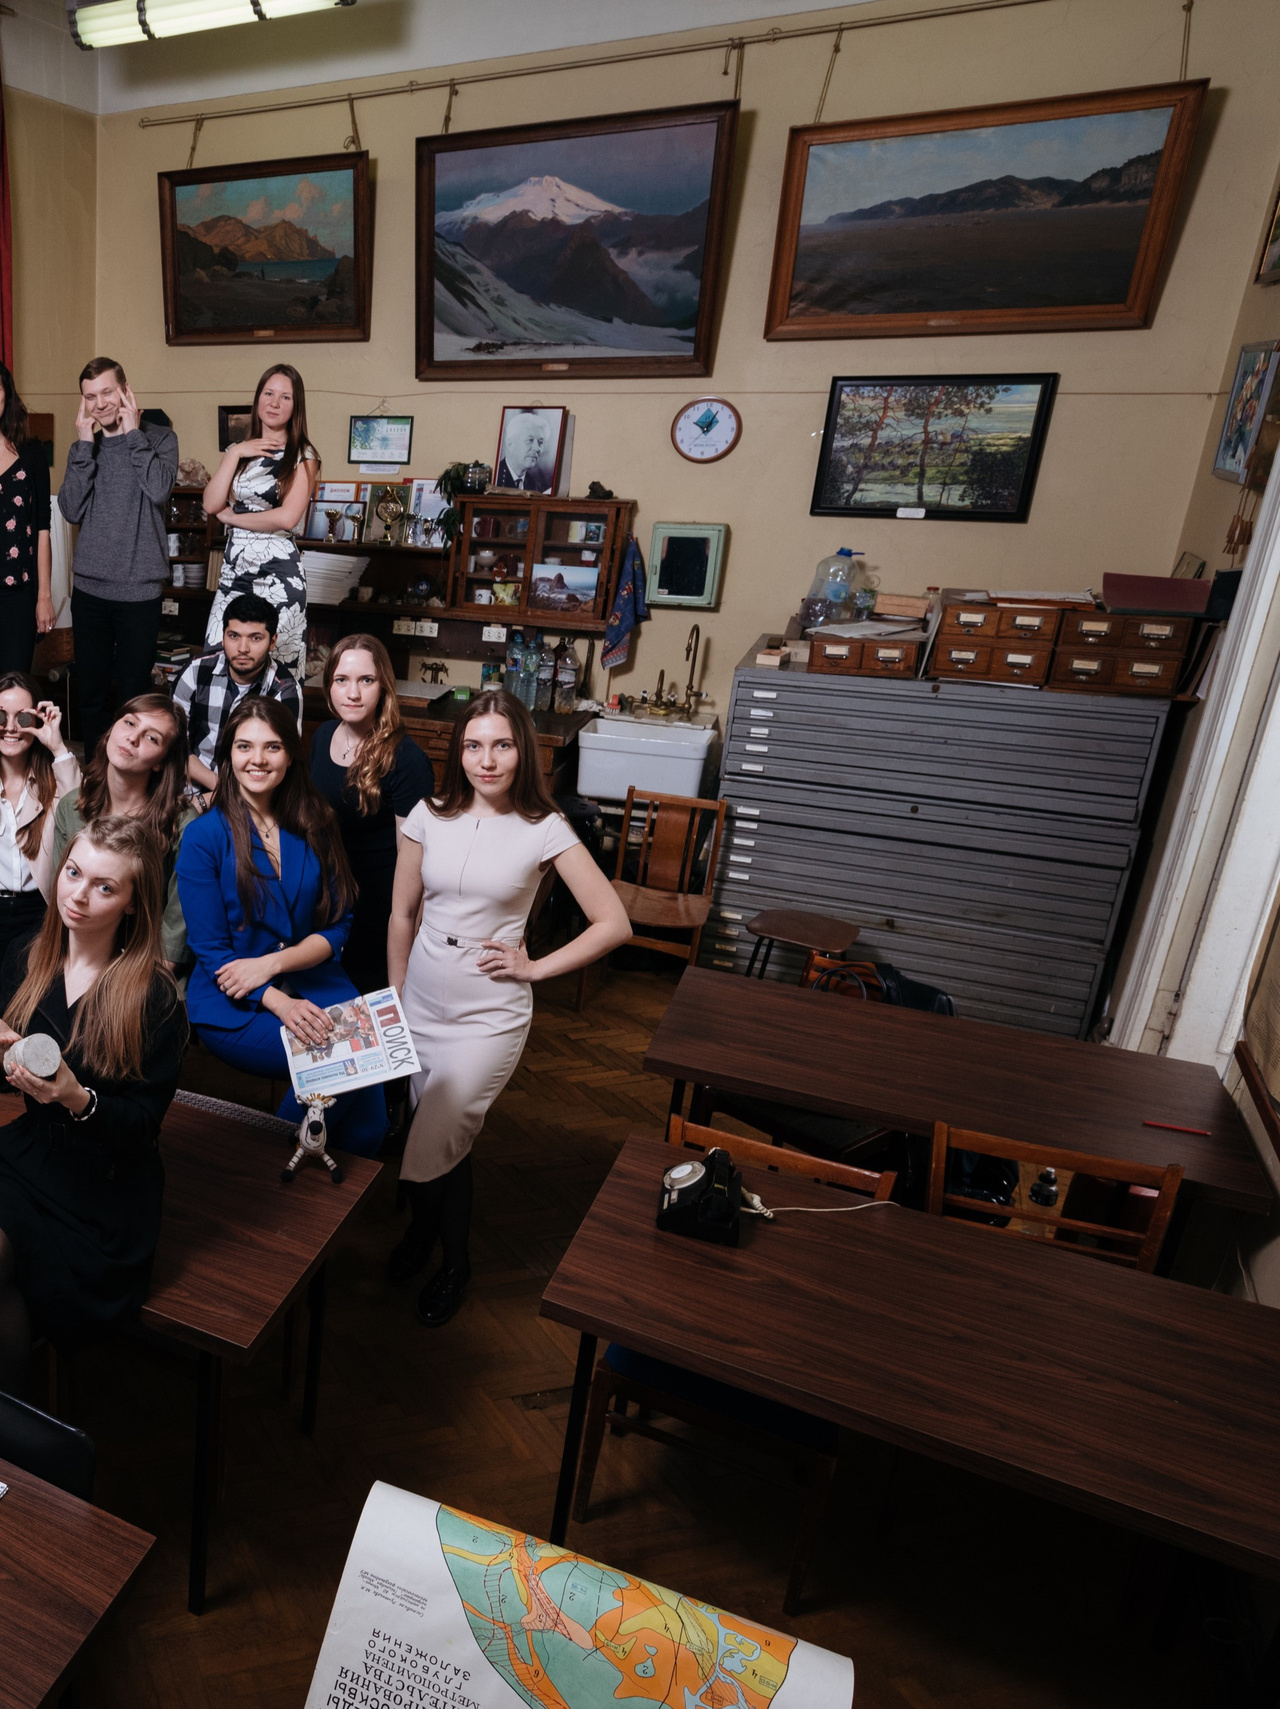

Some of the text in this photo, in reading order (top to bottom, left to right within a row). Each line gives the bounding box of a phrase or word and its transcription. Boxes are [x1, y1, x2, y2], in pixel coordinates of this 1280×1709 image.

[375, 1003, 414, 1070] ПОИСК
[362, 1648, 479, 1708] МЕТРОПОЛИТЕНА
[366, 1638, 462, 1690] ГЛУБОКОГО
[371, 1628, 470, 1681] ЗАЛОЖЕНИЯ
[333, 1679, 389, 1709] ОСКВЫ
